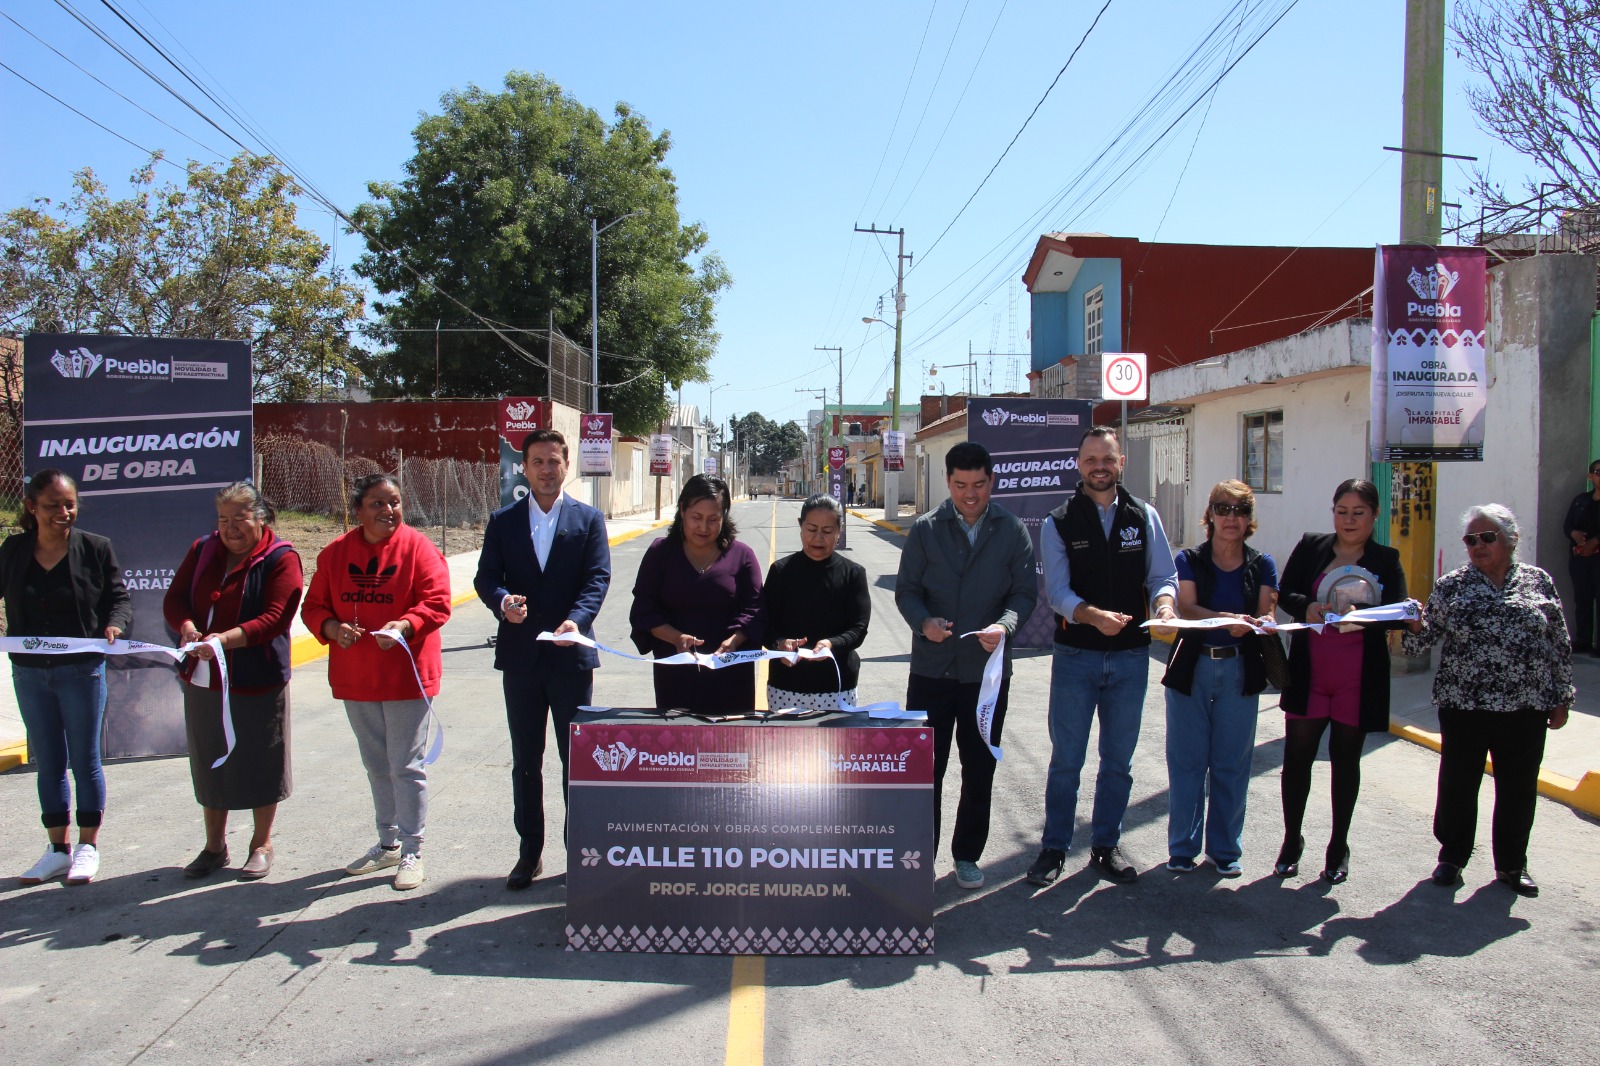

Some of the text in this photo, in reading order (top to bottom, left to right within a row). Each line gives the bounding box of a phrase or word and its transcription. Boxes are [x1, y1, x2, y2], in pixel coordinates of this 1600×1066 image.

[1408, 302, 1461, 318] Puebla
[105, 358, 170, 374] Puebla
[1116, 364, 1132, 380] 30
[1421, 361, 1446, 370] OBRA
[1392, 371, 1478, 382] INAUGURADA
[1010, 414, 1046, 422] Puebla
[1408, 416, 1460, 424] IMPARABLE
[39, 427, 240, 458] INAUGURACIÓN
[82, 459, 196, 482] DE OBRA
[998, 476, 1060, 489] DE OBRA
[341, 590, 394, 604] adidas
[43, 641, 68, 650] Puebla
[639, 752, 694, 766] Puebla
[829, 762, 906, 772] MPARABLE
[608, 822, 708, 832] PAVIMENTACIÓN
[726, 825, 768, 834] OBRAS
[772, 825, 894, 834] COMPLEMENTARIAS
[607, 846, 894, 868] CALLE 110 PONIENTE
[650, 882, 851, 896] PROF. JORGE MURAD M.
